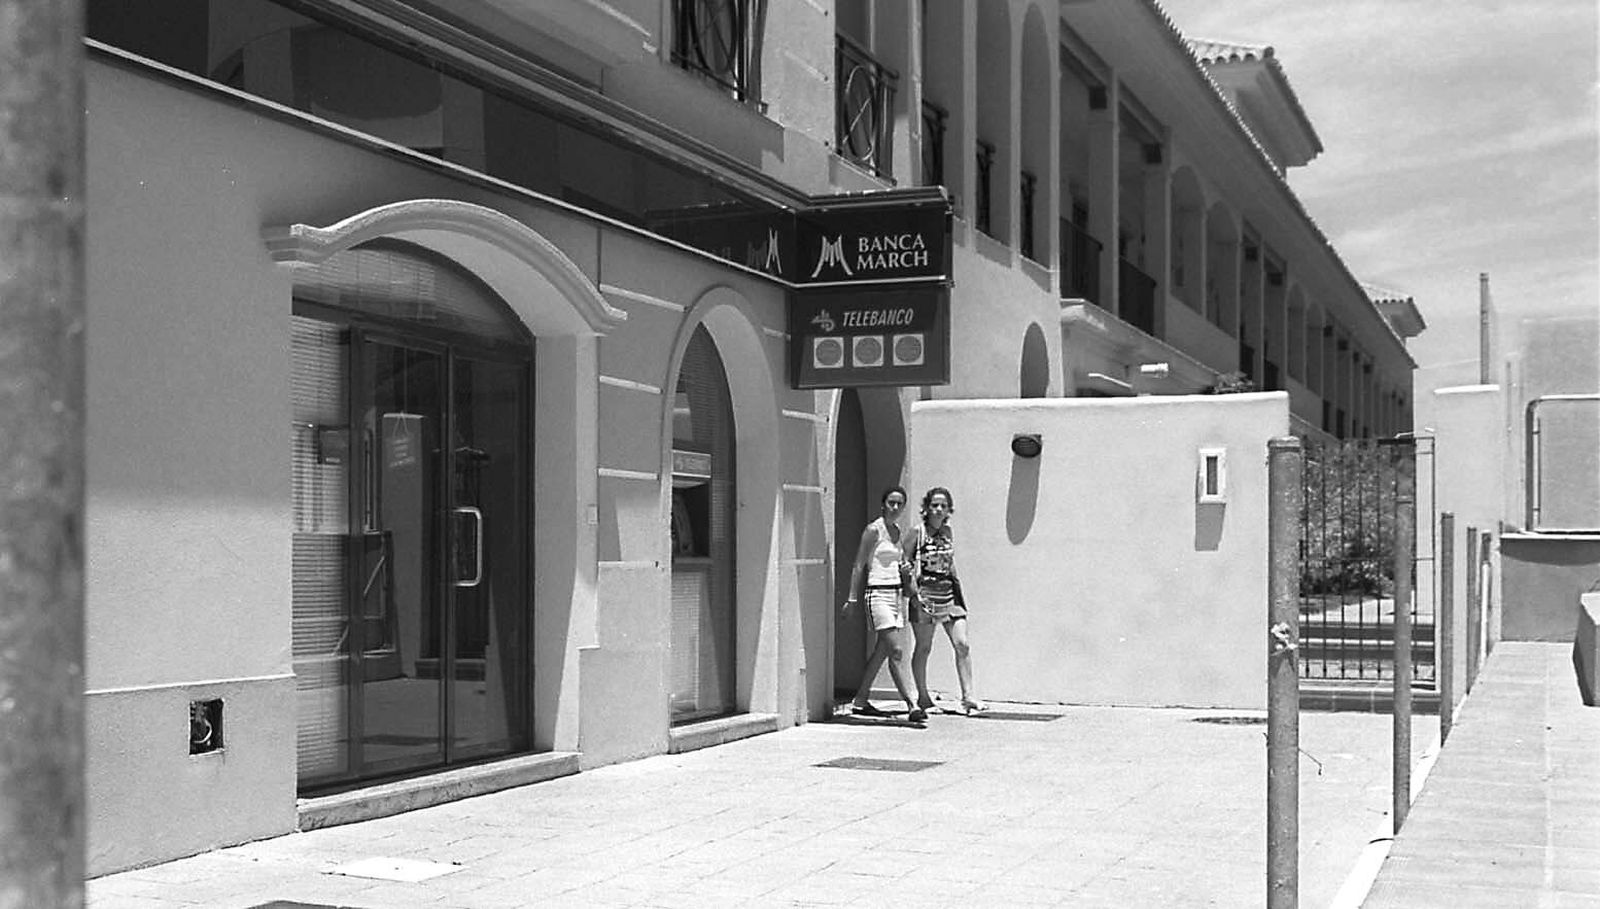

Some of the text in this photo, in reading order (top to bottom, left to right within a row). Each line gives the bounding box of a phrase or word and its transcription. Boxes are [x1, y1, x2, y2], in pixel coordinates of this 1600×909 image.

[858, 234, 925, 252] BANCA
[857, 251, 928, 270] MARCH
[843, 308, 914, 327] TELEBANCO
